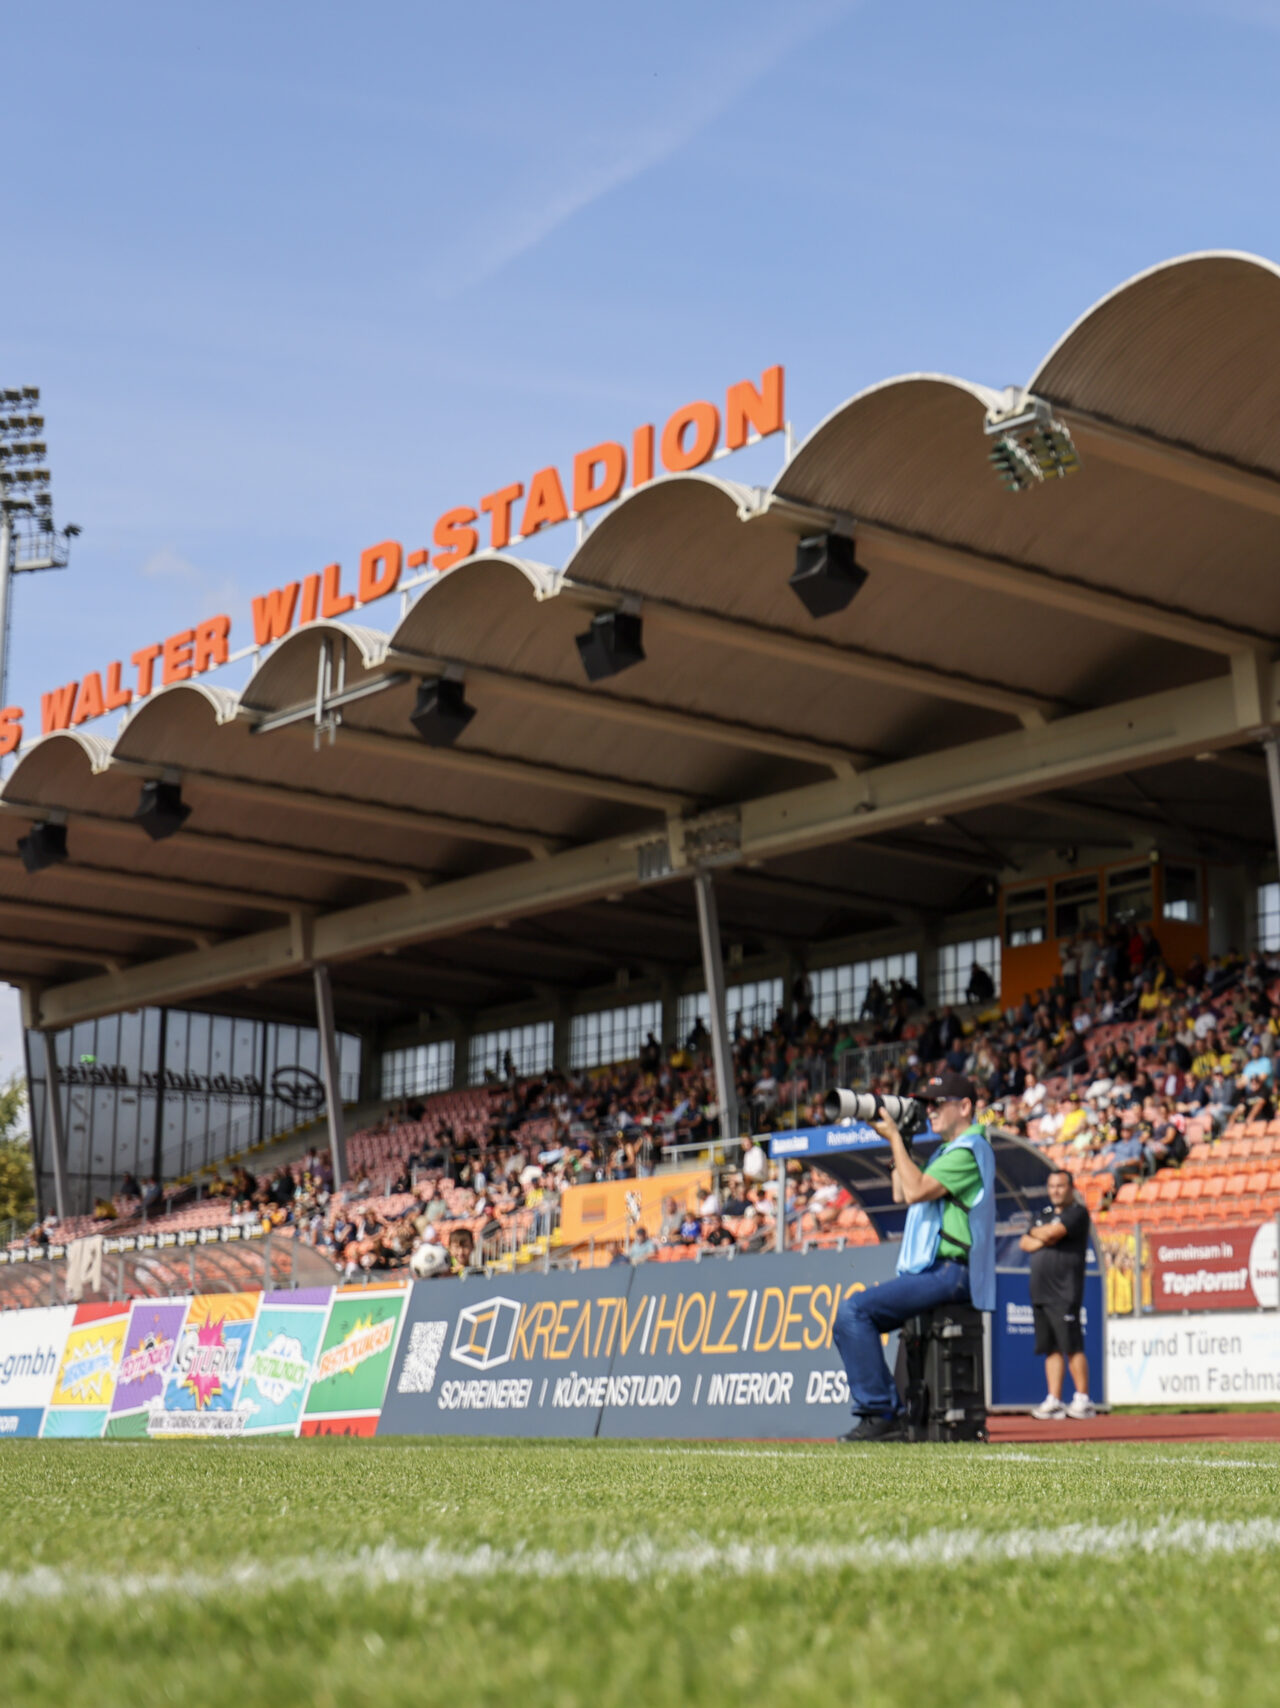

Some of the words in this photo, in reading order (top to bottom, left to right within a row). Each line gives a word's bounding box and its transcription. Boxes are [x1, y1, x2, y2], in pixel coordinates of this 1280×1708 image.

[41, 614, 231, 734] WALTER
[252, 365, 784, 646] WILD-STADION
[1158, 1244, 1220, 1262] Gemeinsam
[1222, 1241, 1233, 1258] in
[1107, 1338, 1135, 1358] ter
[1142, 1333, 1178, 1357] und
[1185, 1331, 1241, 1355] Türen
[181, 1346, 237, 1373] STURM
[438, 1378, 533, 1410] SCHREINEREI
[552, 1370, 681, 1407] KÜCHENSTUDIO
[707, 1371, 794, 1404] INTERIOR
[1159, 1373, 1200, 1393] vom
